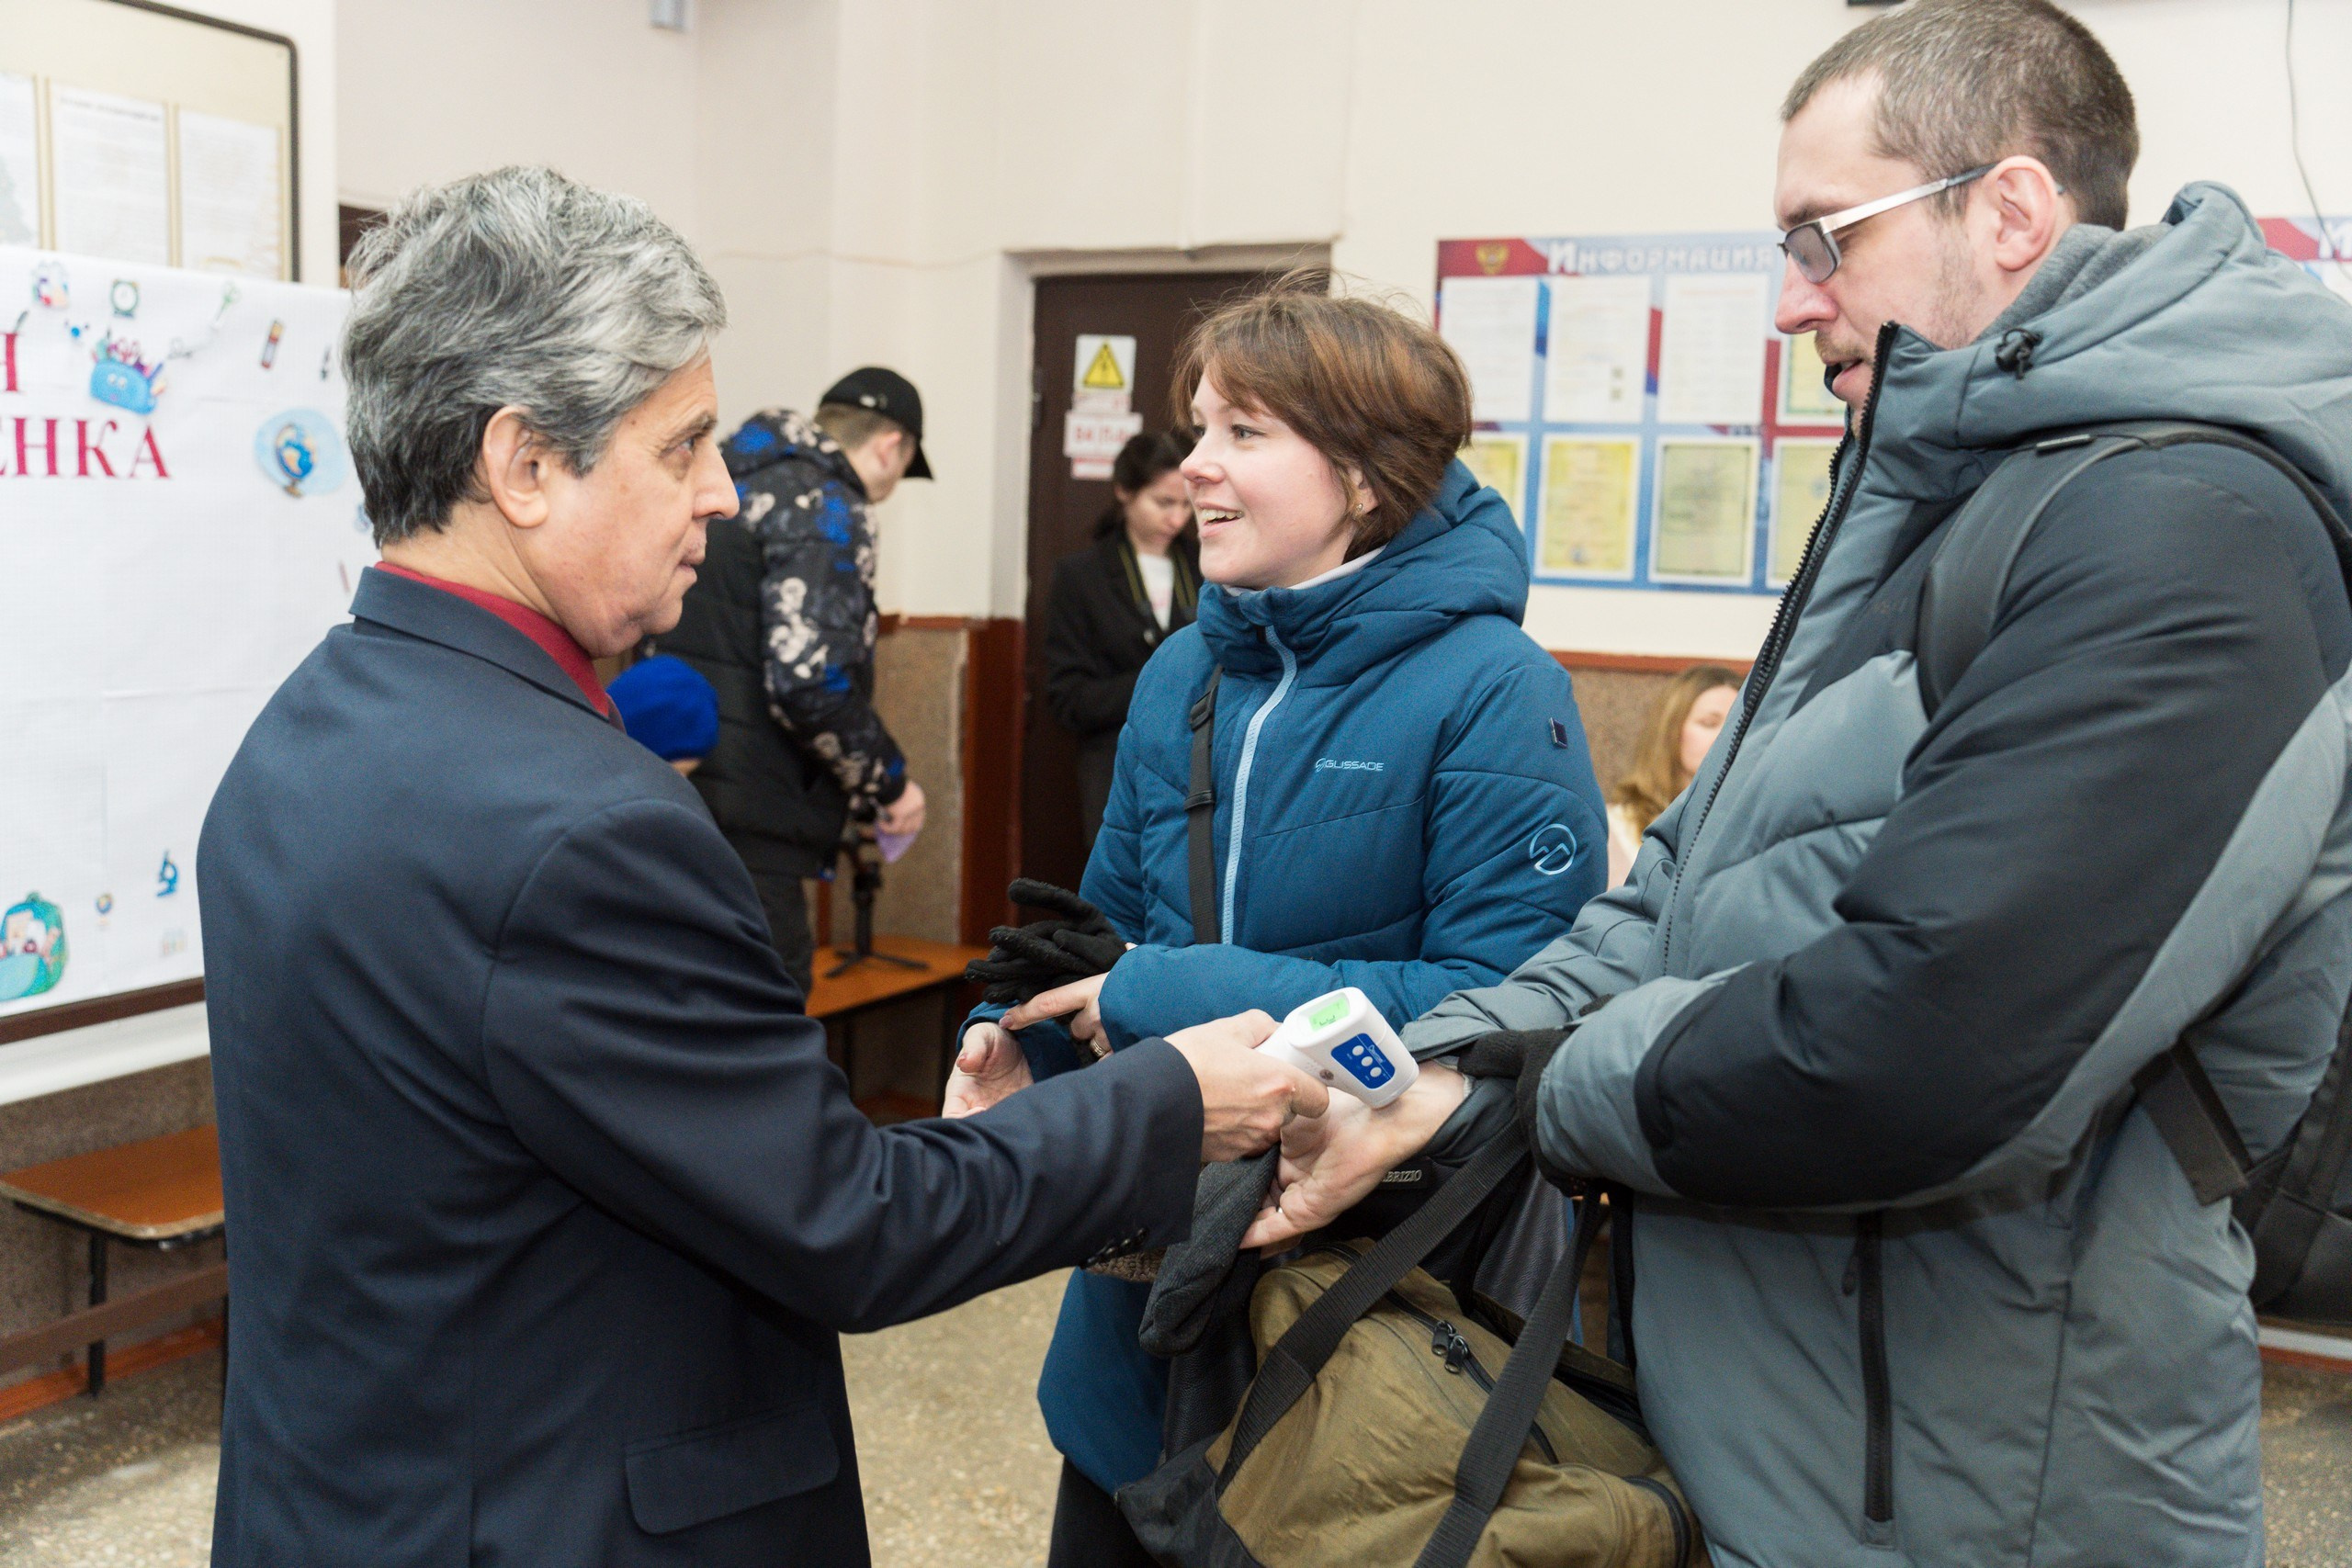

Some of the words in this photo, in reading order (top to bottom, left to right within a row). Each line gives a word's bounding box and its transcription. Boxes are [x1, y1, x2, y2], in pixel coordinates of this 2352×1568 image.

[0, 416, 172, 479] НКА
[1324, 759, 1385, 772] GLISSADE
[1383, 1169, 1422, 1183] BRIZIO
